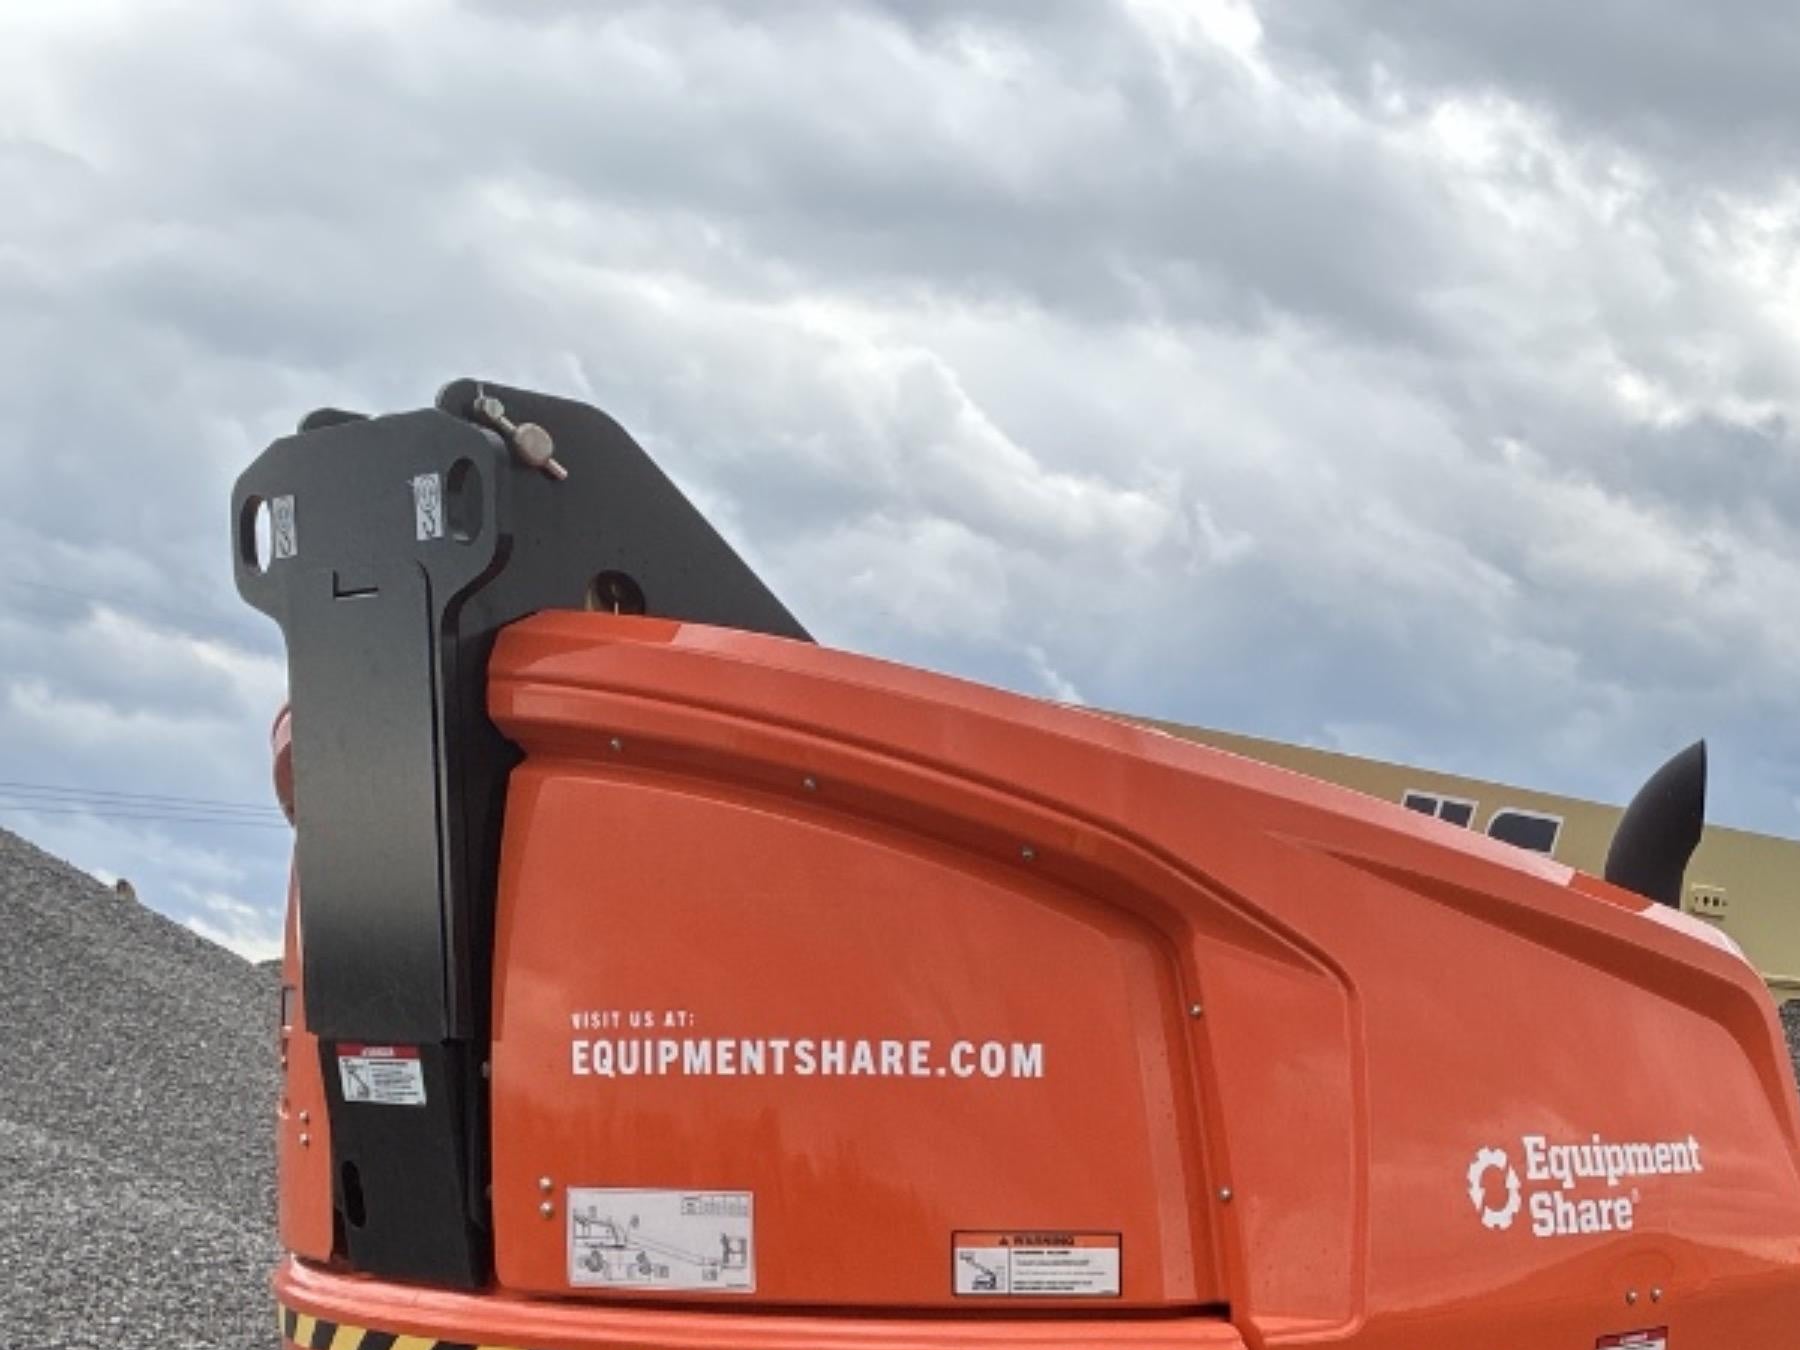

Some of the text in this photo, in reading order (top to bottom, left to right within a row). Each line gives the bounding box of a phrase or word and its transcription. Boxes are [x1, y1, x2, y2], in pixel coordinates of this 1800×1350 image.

[571, 1010, 694, 1029] VISIT US AT:
[571, 1038, 1043, 1078] EQUIPMENTSHARE.COM
[1521, 1133, 1703, 1189] Equipment
[1529, 1191, 1634, 1237] Share
